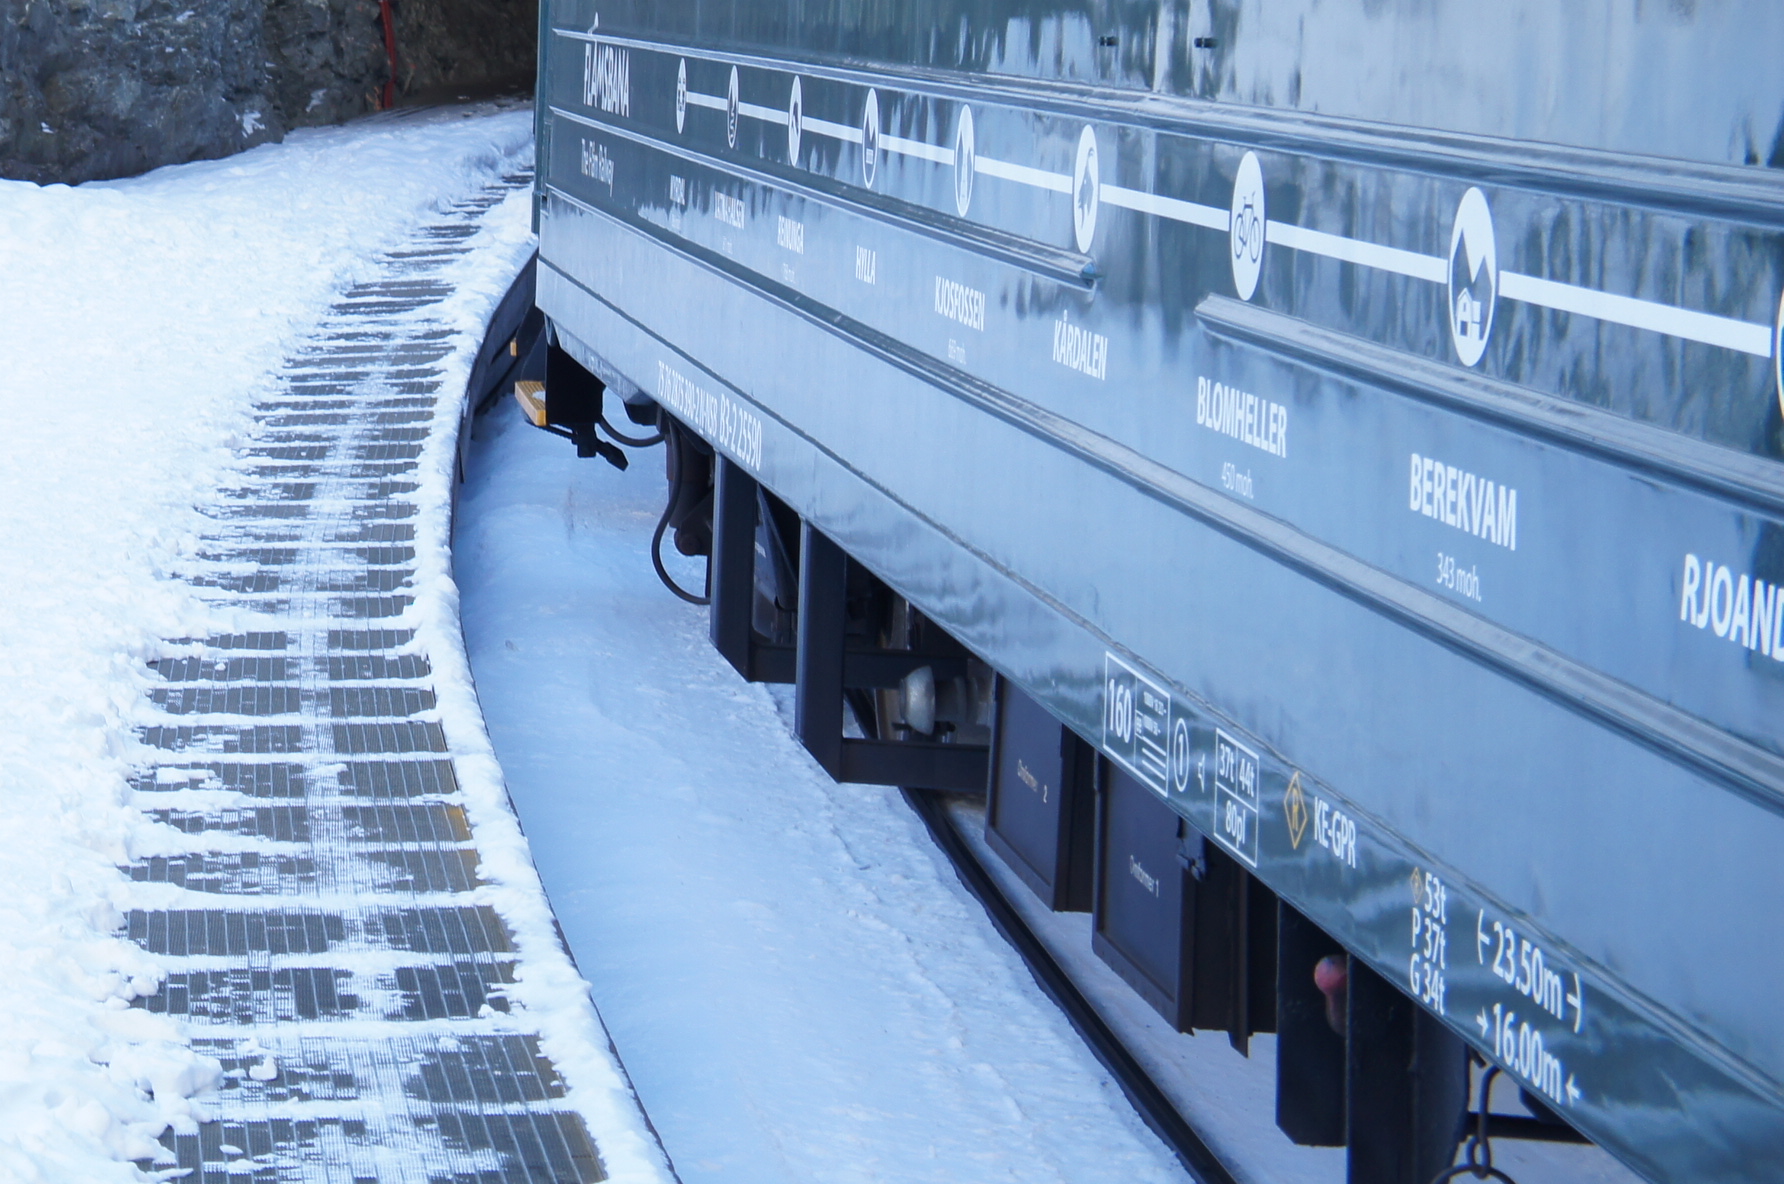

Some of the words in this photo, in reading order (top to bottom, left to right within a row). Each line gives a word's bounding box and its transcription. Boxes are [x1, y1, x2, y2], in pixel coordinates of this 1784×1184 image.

[855, 244, 876, 285] HYLLA
[934, 275, 986, 332] KJOSFOSSEN
[1052, 309, 1108, 381] KÅRDALEN
[719, 393, 737, 452] B3-2
[736, 408, 762, 472] 25590
[1196, 376, 1288, 458] BLOMHELLER
[1221, 461, 1235, 491] 450
[1409, 452, 1517, 551] BEREKVAM
[1436, 552, 1455, 587] 343
[1455, 563, 1482, 603] moh.
[1109, 678, 1132, 744] 160
[1043, 784, 1048, 803] 2
[1219, 743, 1235, 783] 37t
[1239, 758, 1255, 798] 44t
[1225, 799, 1246, 848] 80pl
[1314, 796, 1356, 868] KE-GPR
[1424, 872, 1447, 925] 53t
[1411, 907, 1421, 948] P
[1423, 917, 1446, 970] 37t
[1410, 953, 1421, 996] G
[1423, 962, 1445, 1016] 34t
[1493, 921, 1563, 1020] 23.50m
[1493, 1002, 1562, 1105] 16.00m
